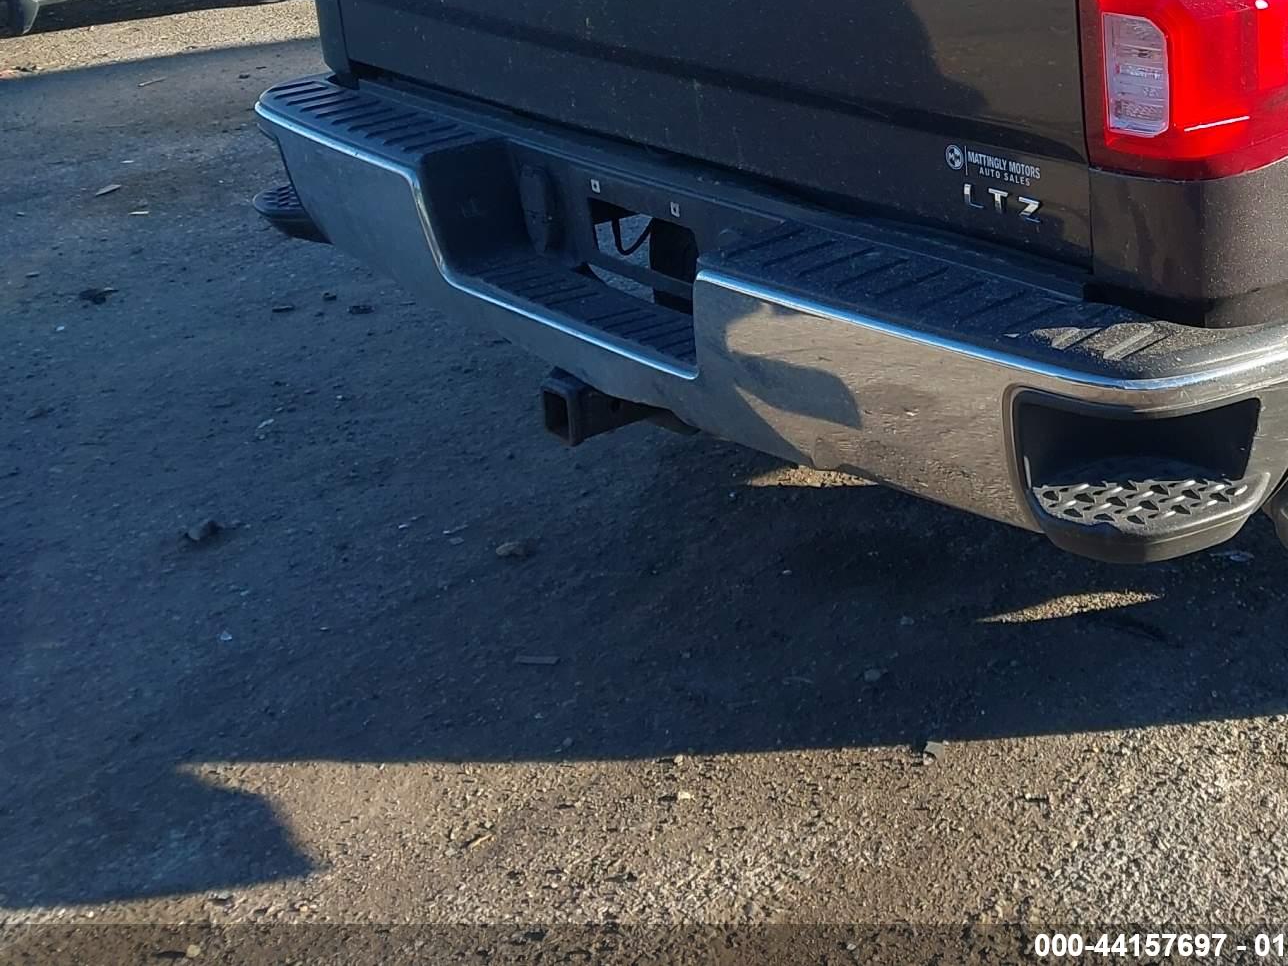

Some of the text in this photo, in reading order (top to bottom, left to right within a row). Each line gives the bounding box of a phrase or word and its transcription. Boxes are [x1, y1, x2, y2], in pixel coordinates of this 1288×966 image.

[967, 151, 1007, 171] MATTINGLY
[1008, 161, 1041, 179] MOTORS
[979, 166, 1031, 186] AUTO SALES
[963, 184, 1041, 223] LTZ
